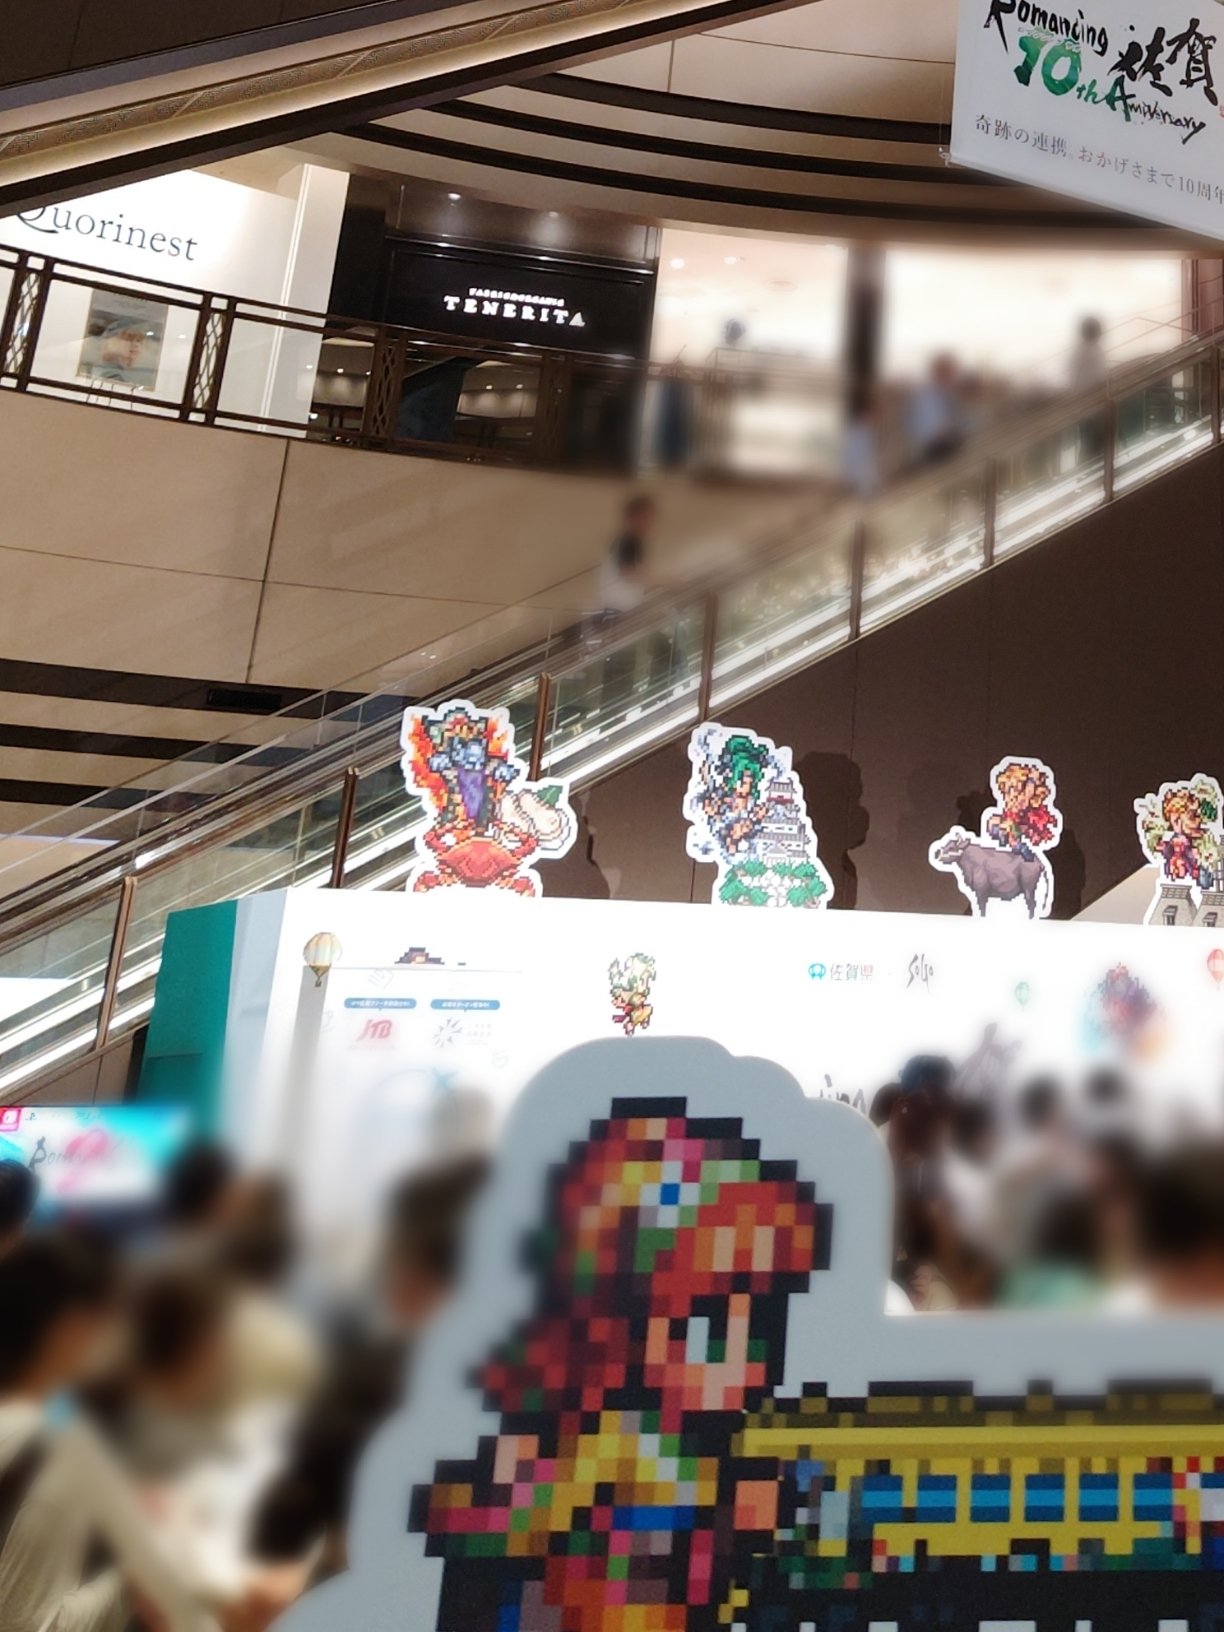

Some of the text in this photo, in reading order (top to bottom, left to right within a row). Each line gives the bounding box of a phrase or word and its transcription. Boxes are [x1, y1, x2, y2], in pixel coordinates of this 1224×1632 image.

[443, 295, 586, 328] TENERITA
[830, 963, 874, 981] 佐賀県
[355, 1019, 393, 1042] JTB
